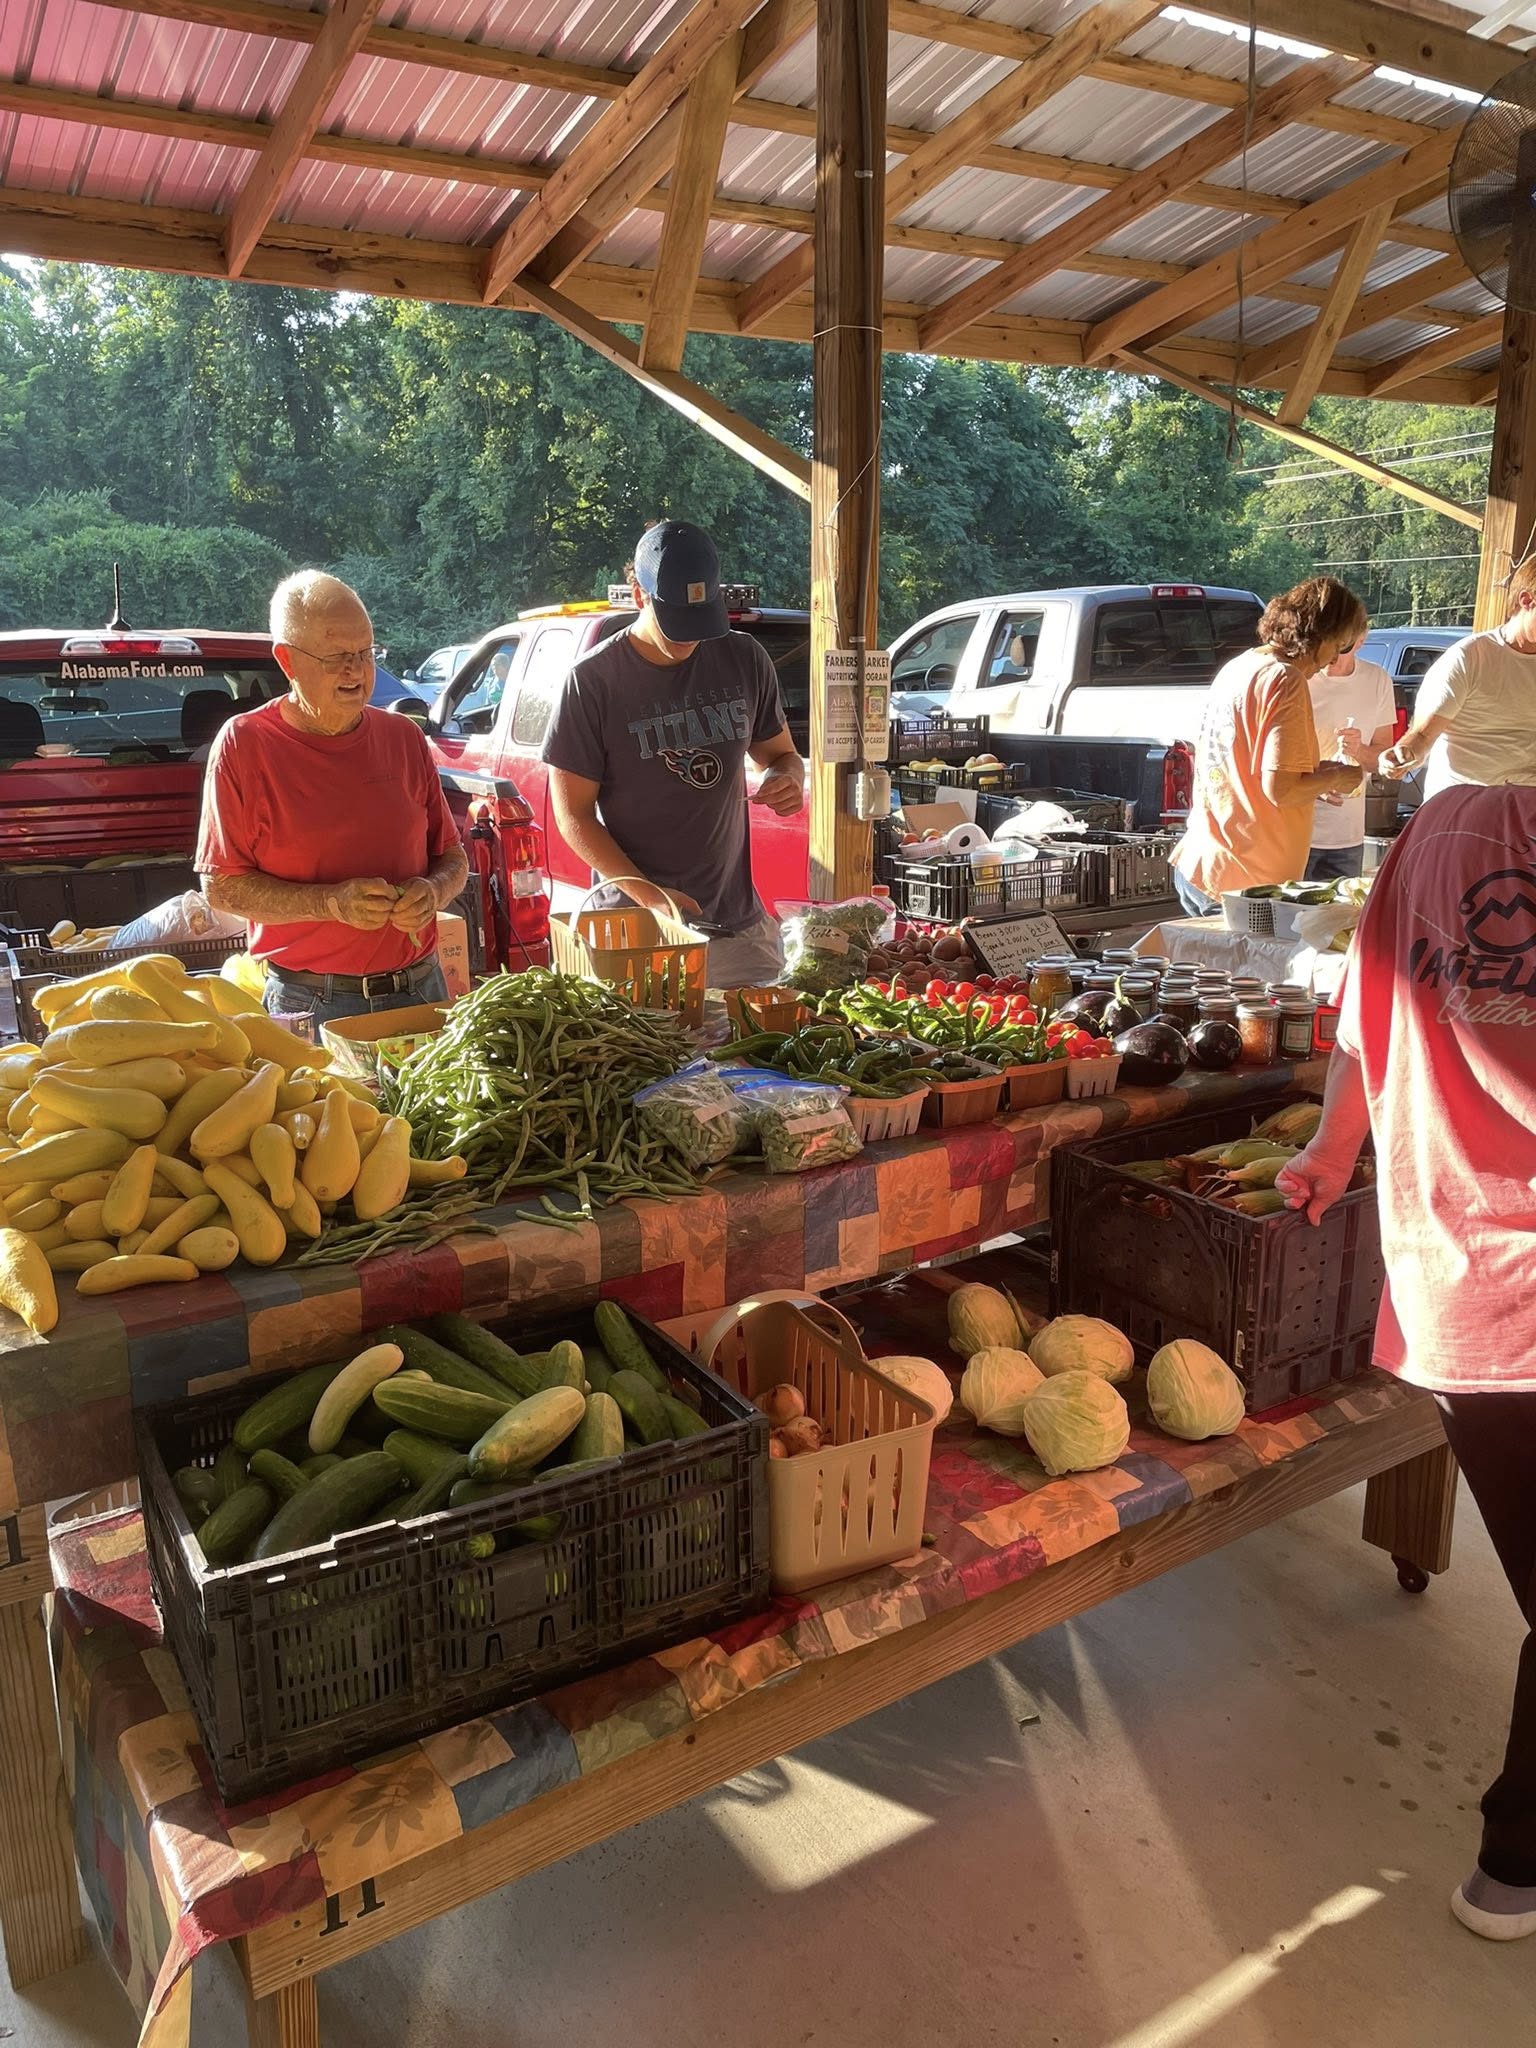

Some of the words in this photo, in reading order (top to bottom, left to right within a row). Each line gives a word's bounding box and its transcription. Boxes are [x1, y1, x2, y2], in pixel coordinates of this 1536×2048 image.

[826, 655, 858, 668] FARMERS
[865, 656, 889, 668] ARKET
[61, 661, 204, 679] AlabamaFord.com
[827, 672, 858, 681] NUTRITION
[865, 673, 888, 681] OGRAM
[628, 699, 749, 759] TITANS
